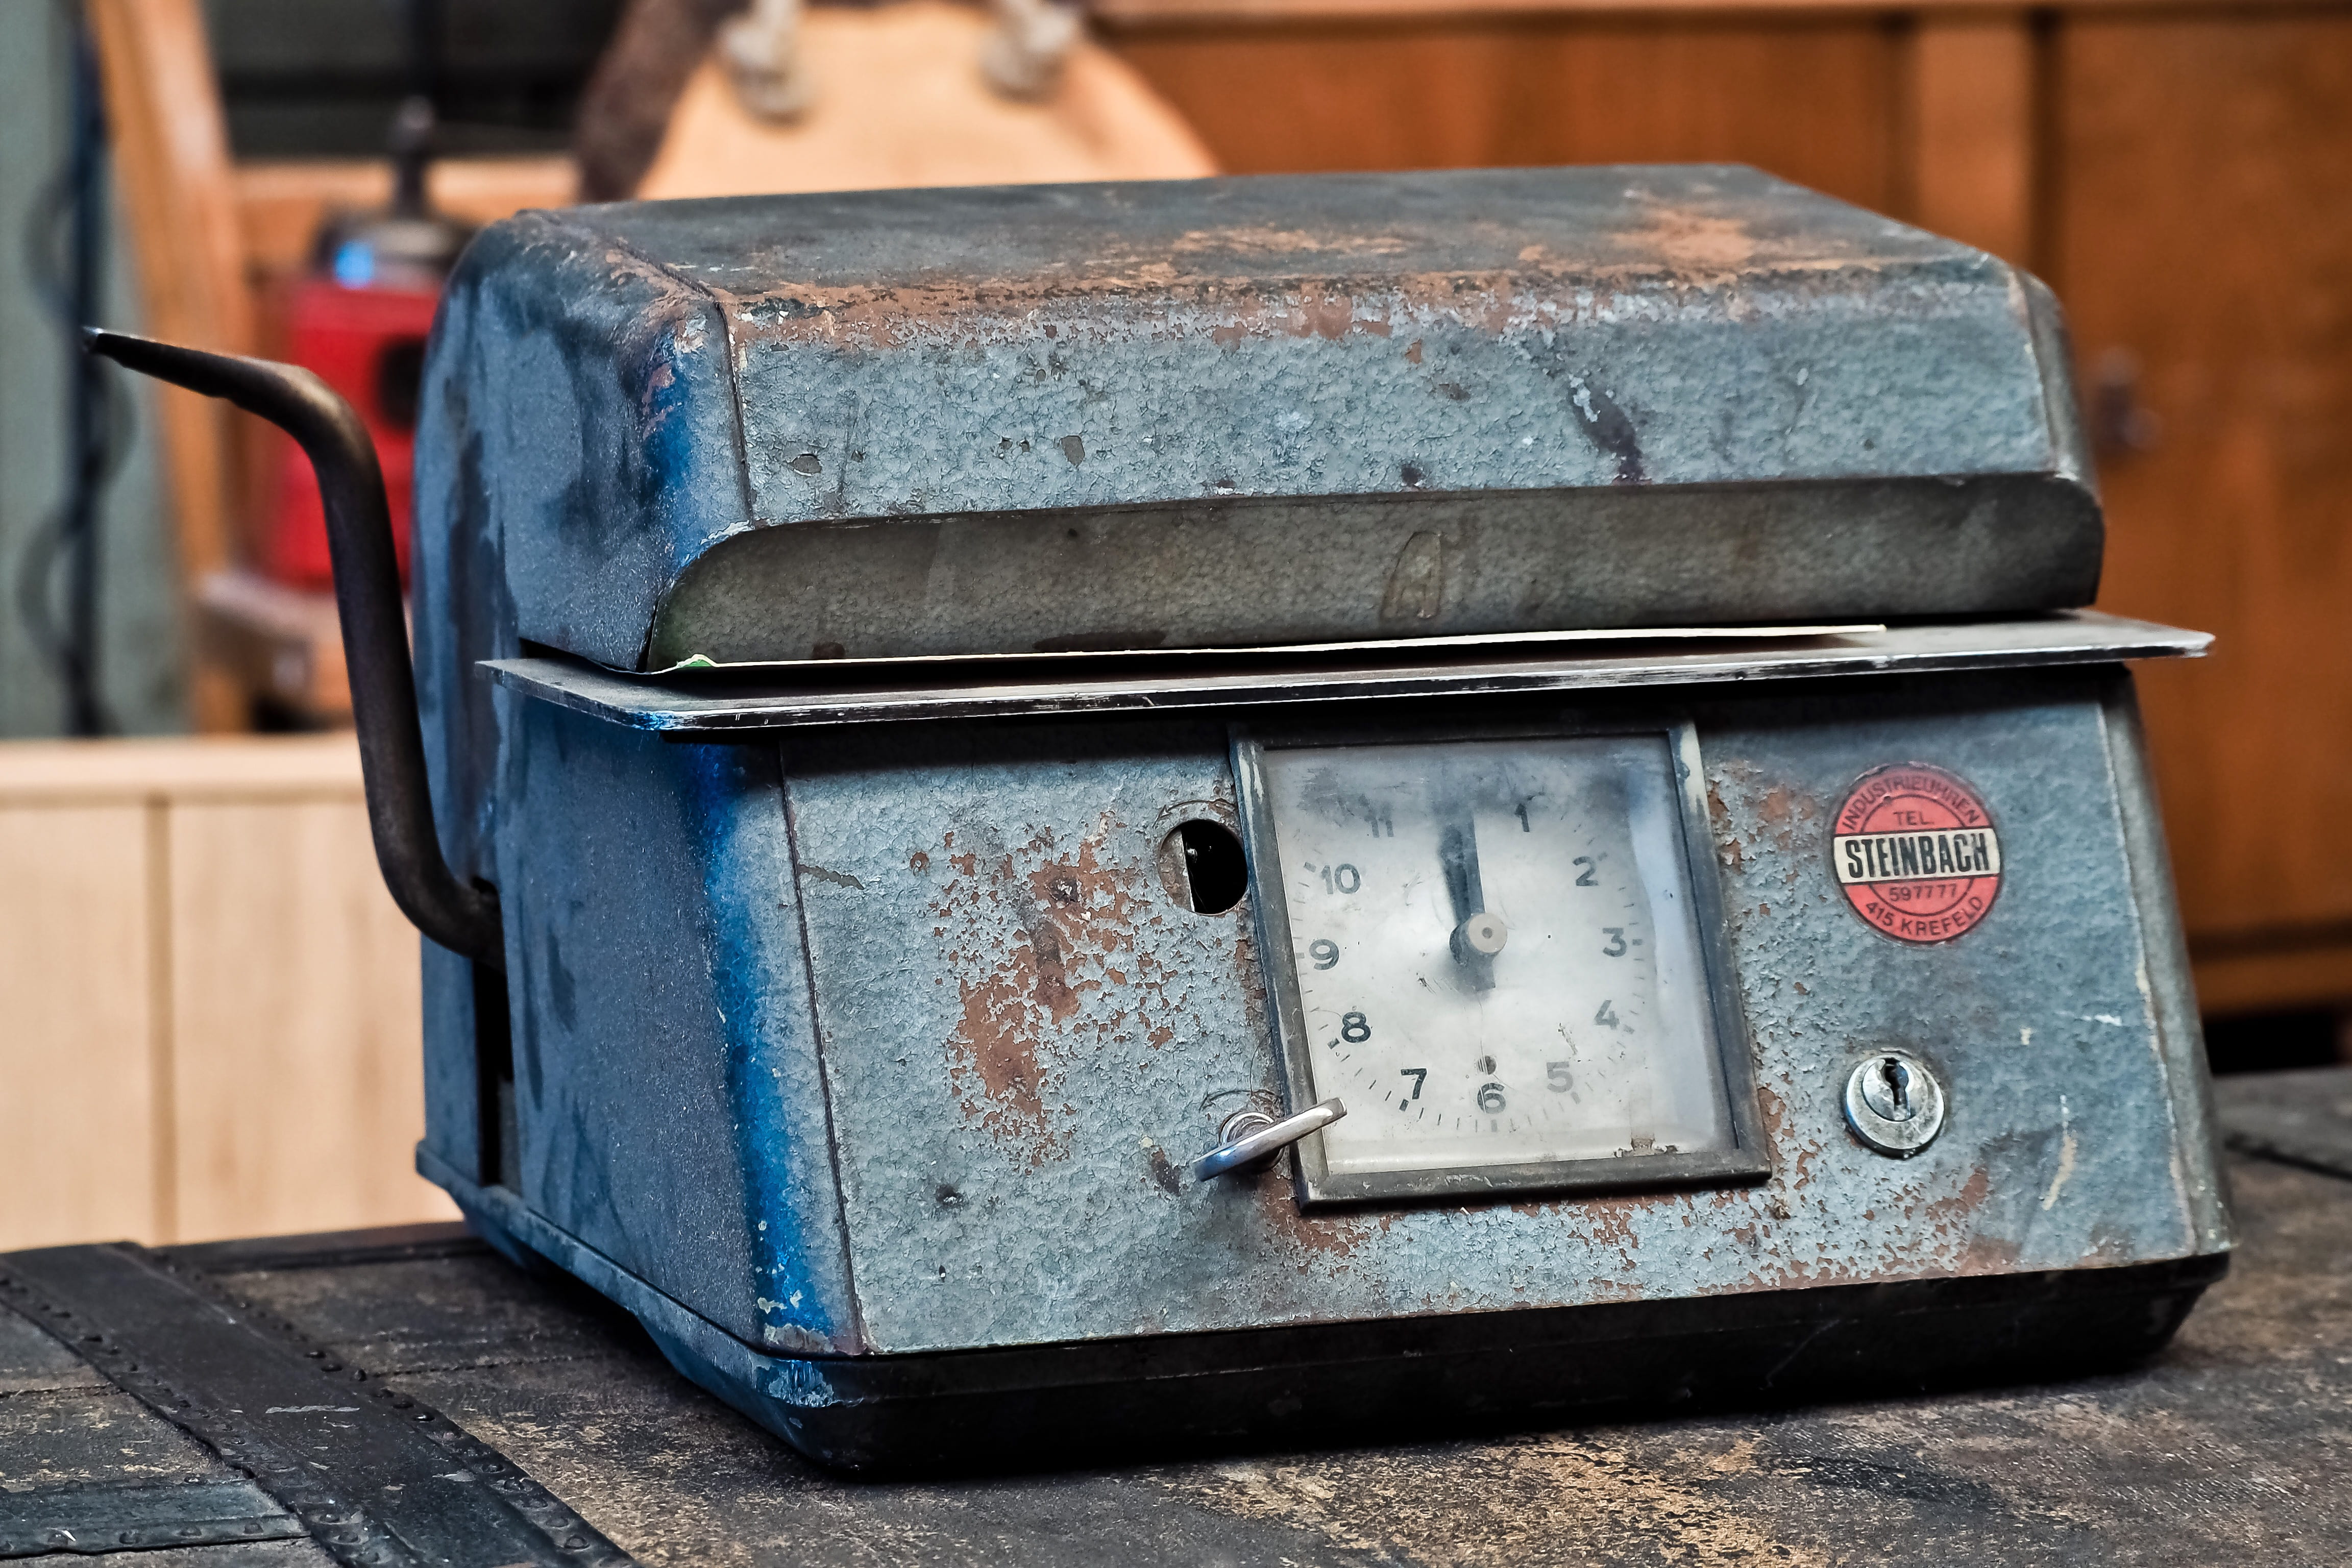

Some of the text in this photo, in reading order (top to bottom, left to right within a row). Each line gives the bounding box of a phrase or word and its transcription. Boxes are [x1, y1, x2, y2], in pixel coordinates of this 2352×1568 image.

[1514, 803, 1530, 832] 1
[1572, 855, 1599, 887] 2
[1845, 832, 1990, 879] STEINBACH
[1320, 863, 1361, 895] 10
[1890, 883, 1956, 902] 597777
[1866, 896, 1982, 936] 415 KREFELD
[1309, 938, 1340, 970] 9
[1602, 927, 1628, 958] 3
[1341, 1011, 1372, 1043] 8
[1594, 999, 1620, 1030] 4
[1400, 1067, 1428, 1100] 7
[1545, 1061, 1574, 1094] 5
[1477, 1083, 1507, 1115] 6
